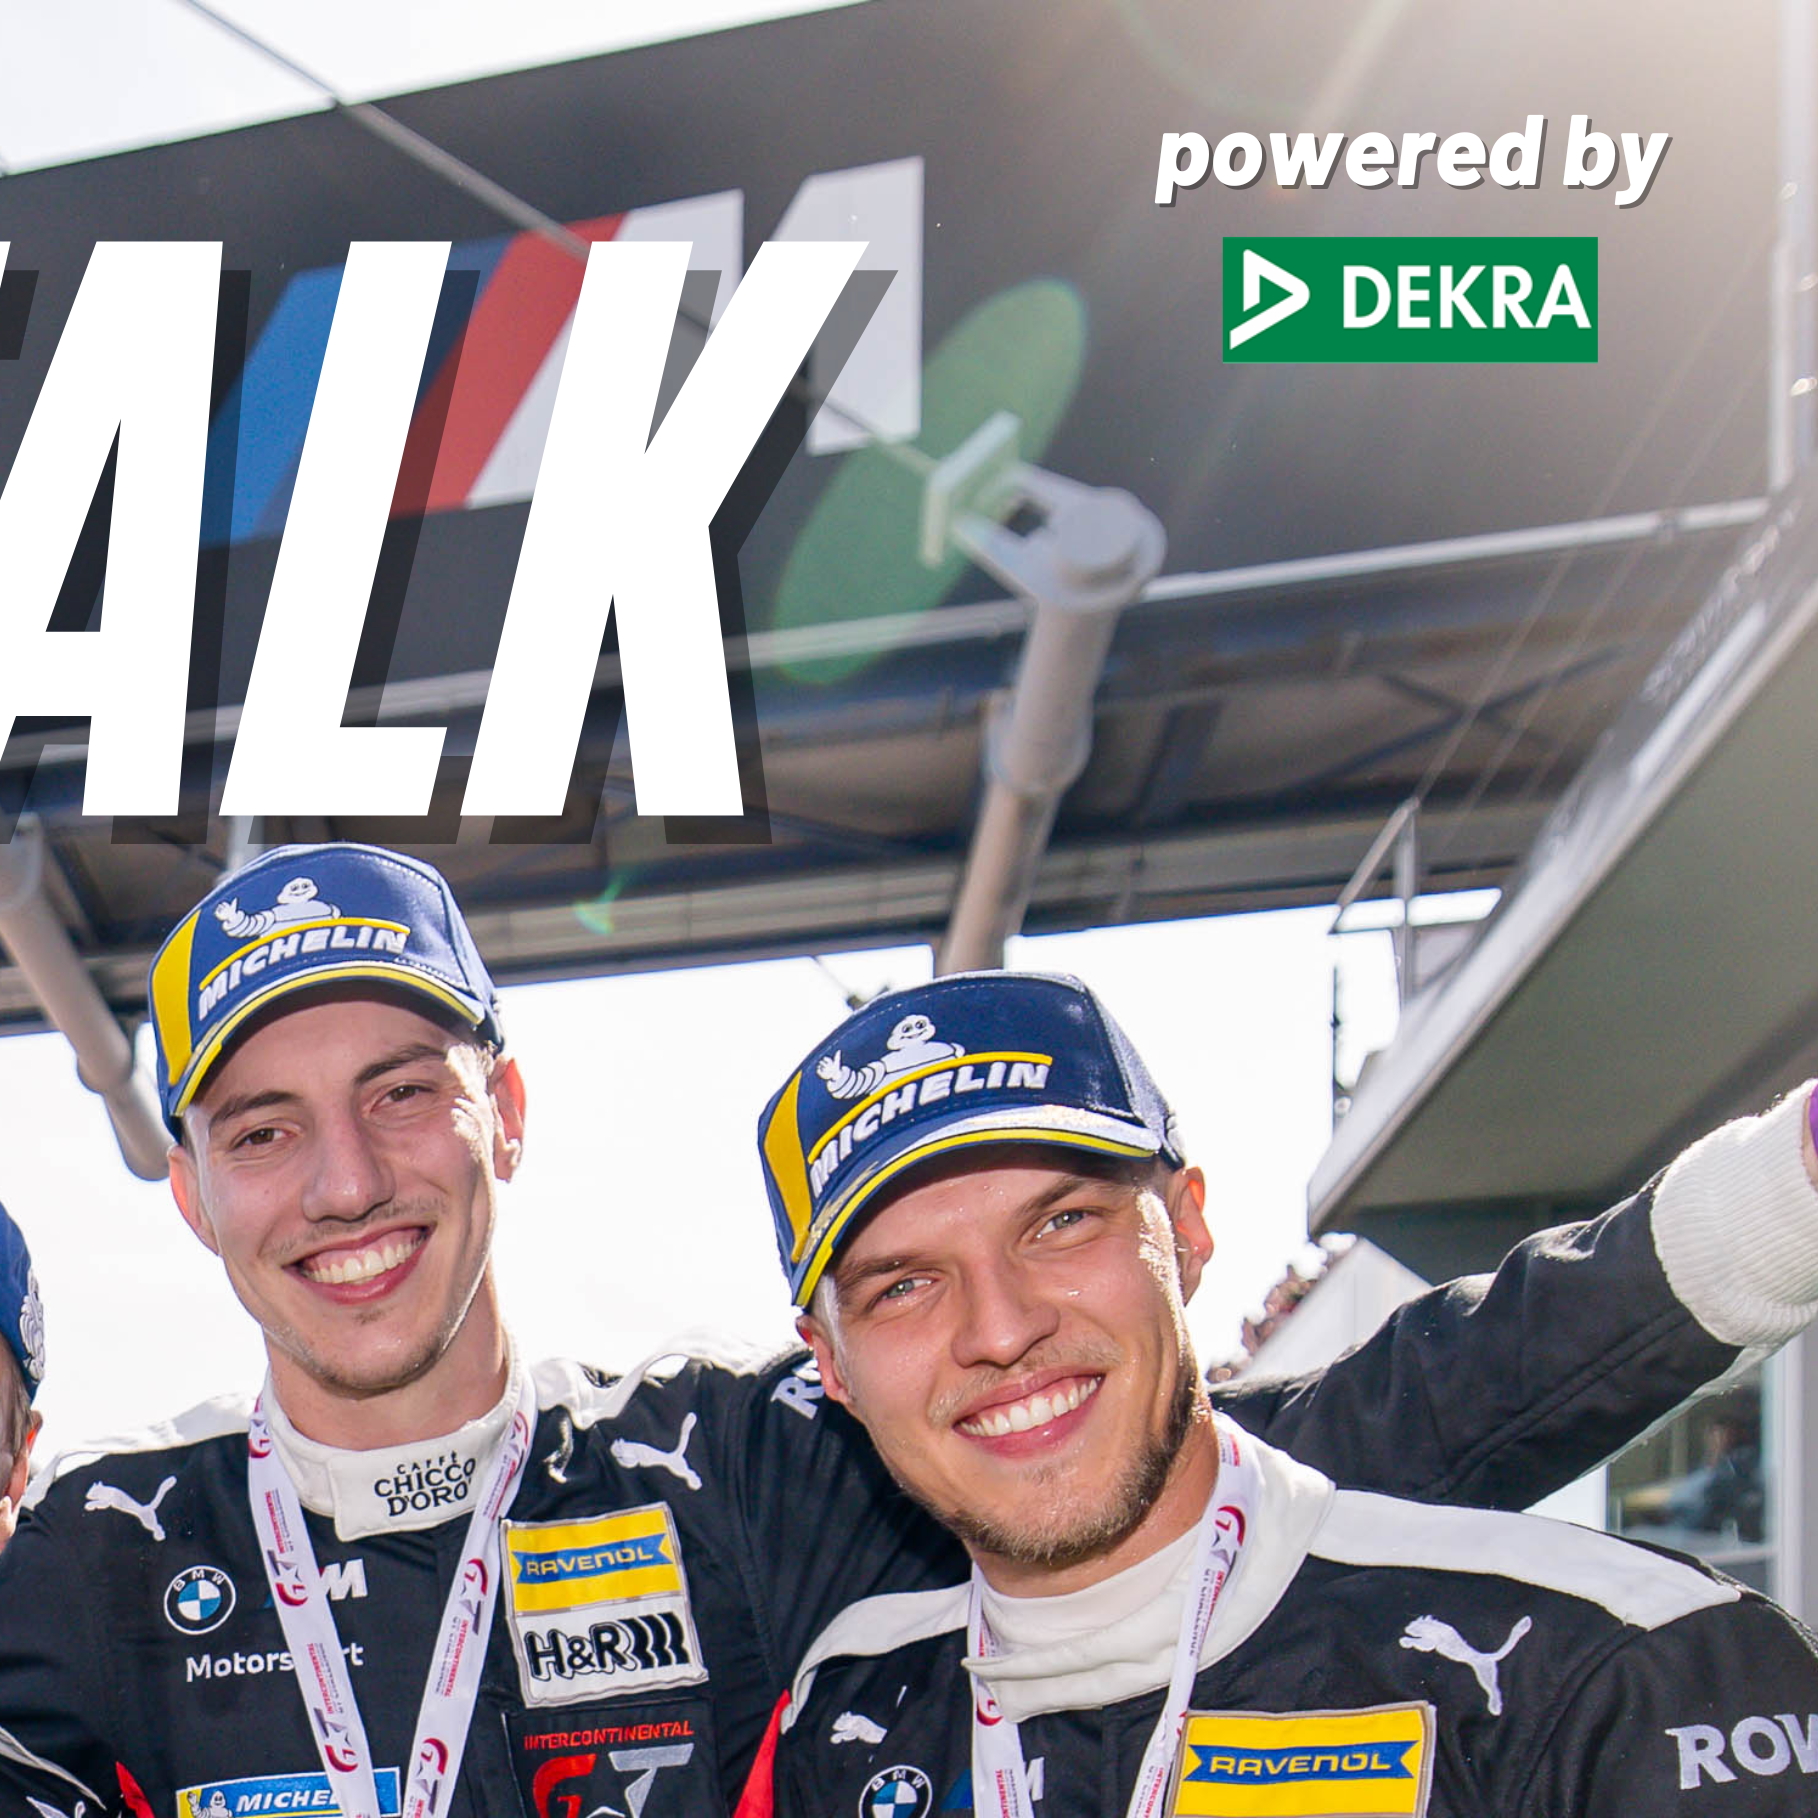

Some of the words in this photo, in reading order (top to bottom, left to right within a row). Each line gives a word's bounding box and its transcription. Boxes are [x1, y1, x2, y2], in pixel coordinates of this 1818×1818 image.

[197, 923, 409, 1022] MICHELIN
[808, 1061, 1049, 1197] MICHELIN
[374, 1458, 476, 1498] CHICCO
[526, 1545, 654, 1578] RAVENOL
[523, 1719, 695, 1753] INTERCONTINENTAL
[1665, 1712, 1818, 1790] ROW
[1209, 1748, 1393, 1777] RAVENOL
